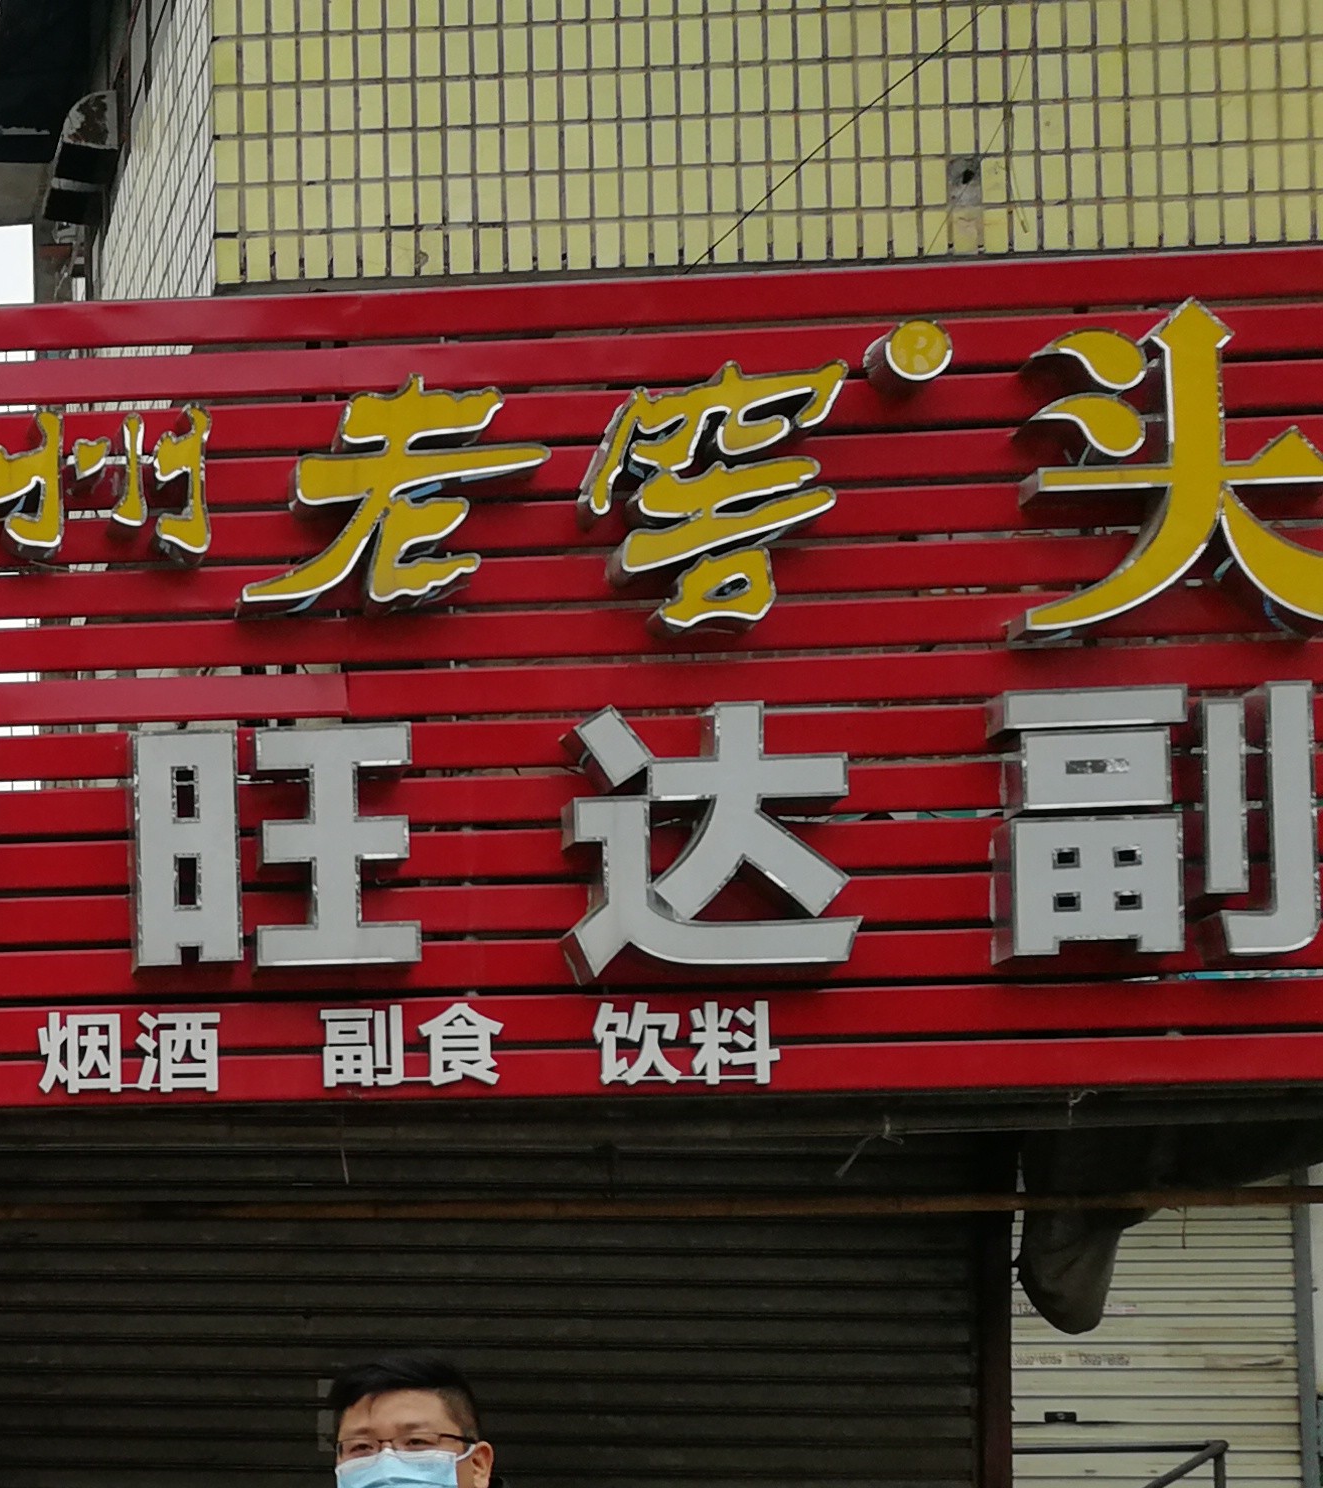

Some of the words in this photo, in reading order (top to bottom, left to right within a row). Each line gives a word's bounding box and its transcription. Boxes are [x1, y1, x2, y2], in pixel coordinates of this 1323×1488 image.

[38, 1011, 222, 1097] 烟酒
[319, 1006, 505, 1090] 副食
[593, 1000, 782, 1088] 饮料
